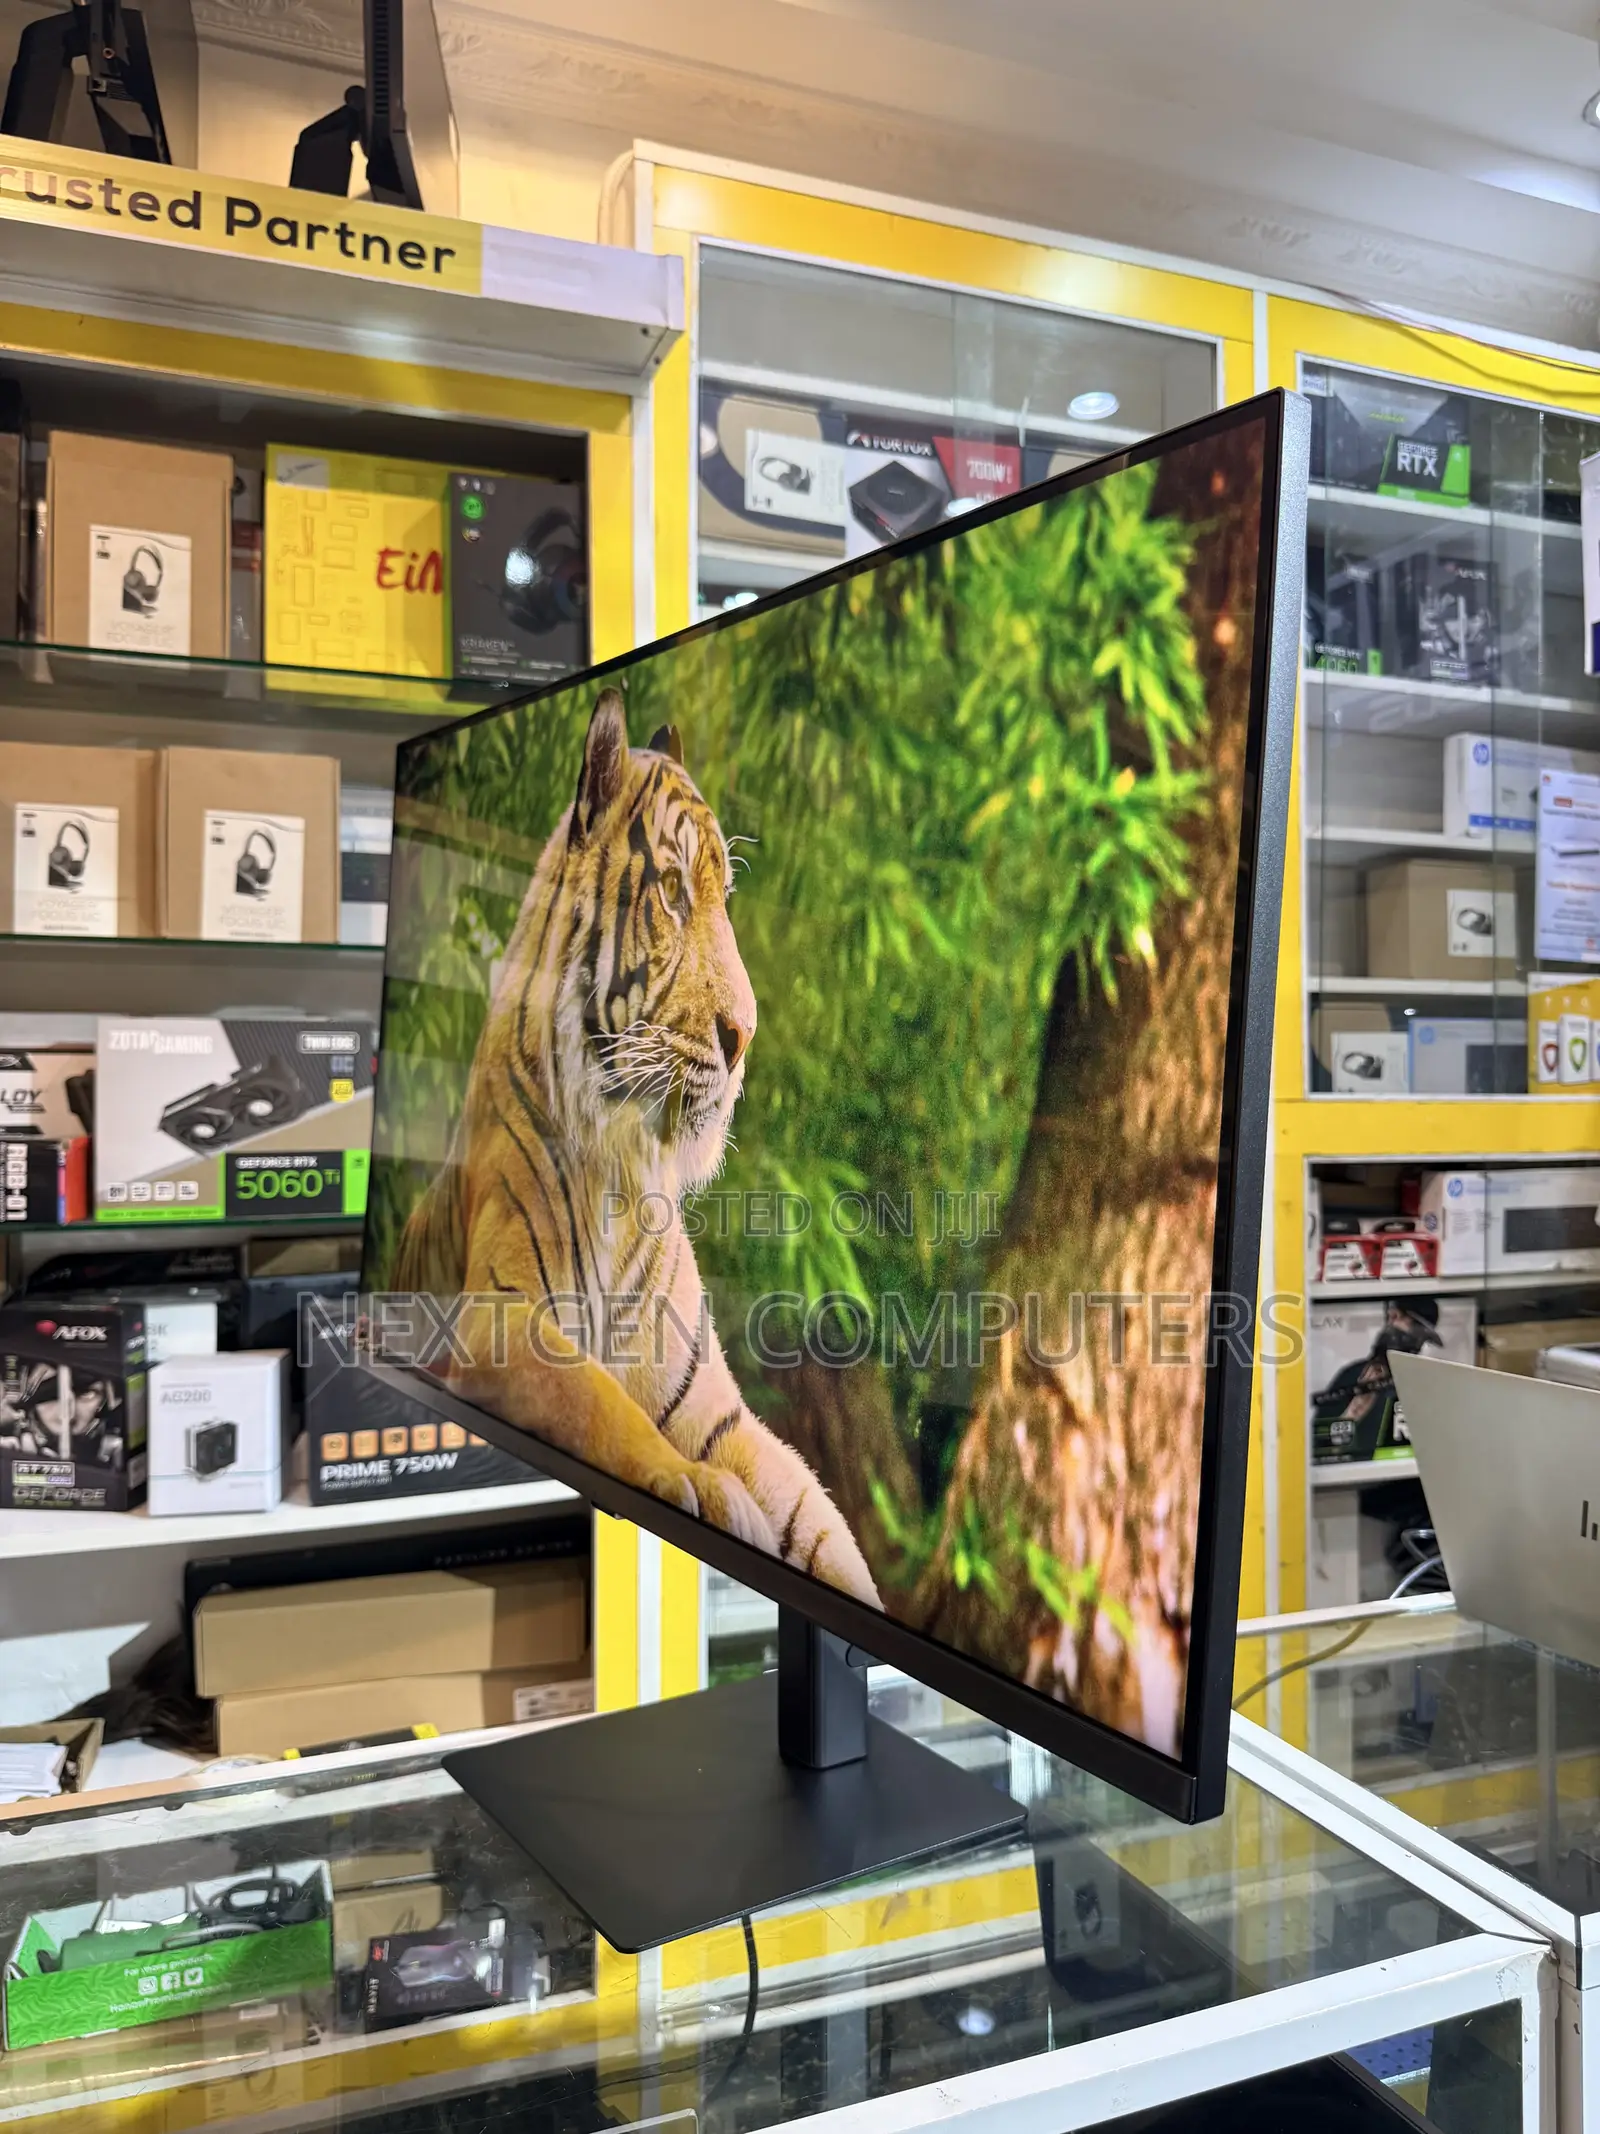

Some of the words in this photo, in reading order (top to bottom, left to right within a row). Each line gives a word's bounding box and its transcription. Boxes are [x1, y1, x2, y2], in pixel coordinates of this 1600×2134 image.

[226, 195, 456, 274] Partner
[1397, 451, 1438, 478] RTX
[236, 1157, 292, 1169] GEFORCE
[294, 1156, 318, 1168] RTX
[235, 1169, 323, 1200] 5060
[53, 1325, 108, 1341] AFOX
[320, 1459, 391, 1482] PRIME
[395, 1452, 459, 1476] 750W
